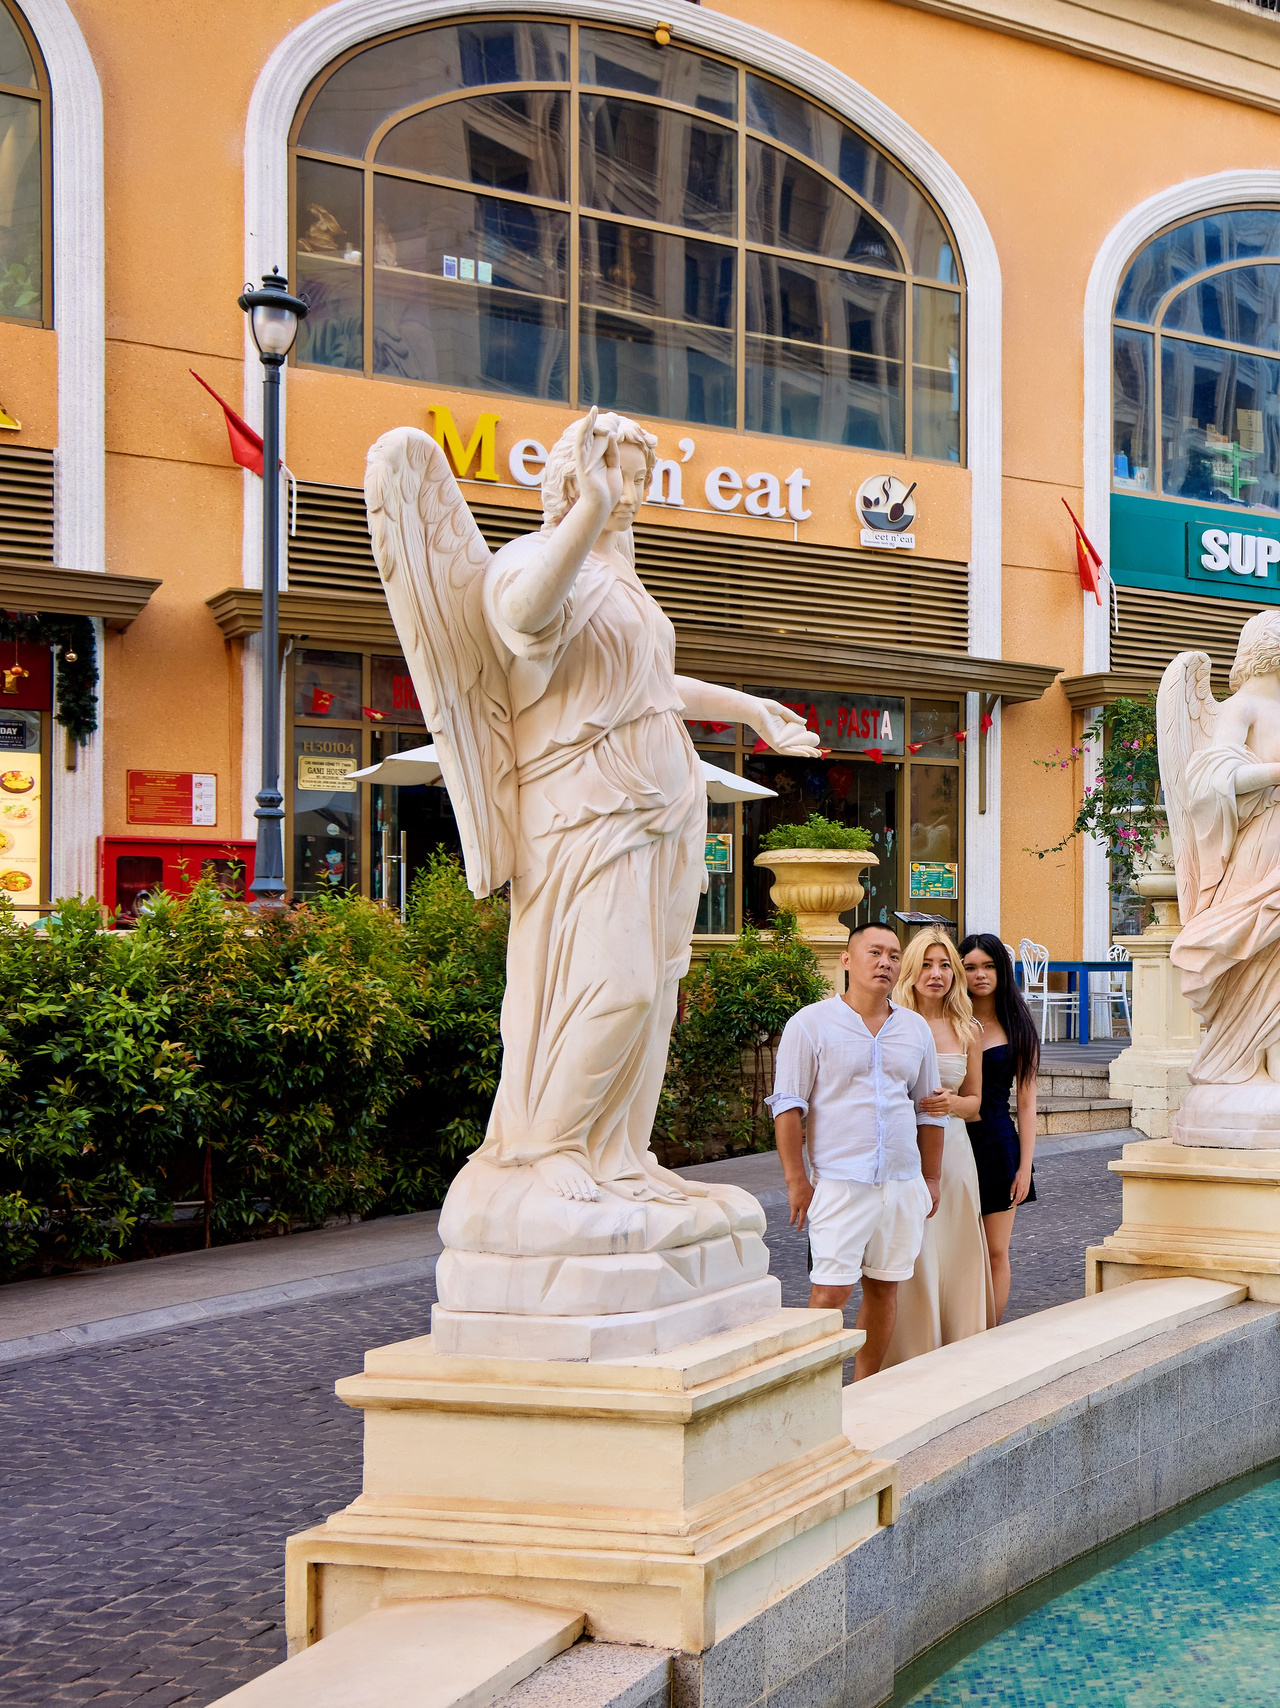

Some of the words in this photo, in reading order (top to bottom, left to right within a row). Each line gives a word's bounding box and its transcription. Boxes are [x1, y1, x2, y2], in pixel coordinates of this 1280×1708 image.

[837, 706, 893, 741] PASTA
[302, 740, 355, 754] H30104
[307, 767, 325, 775] GAMI
